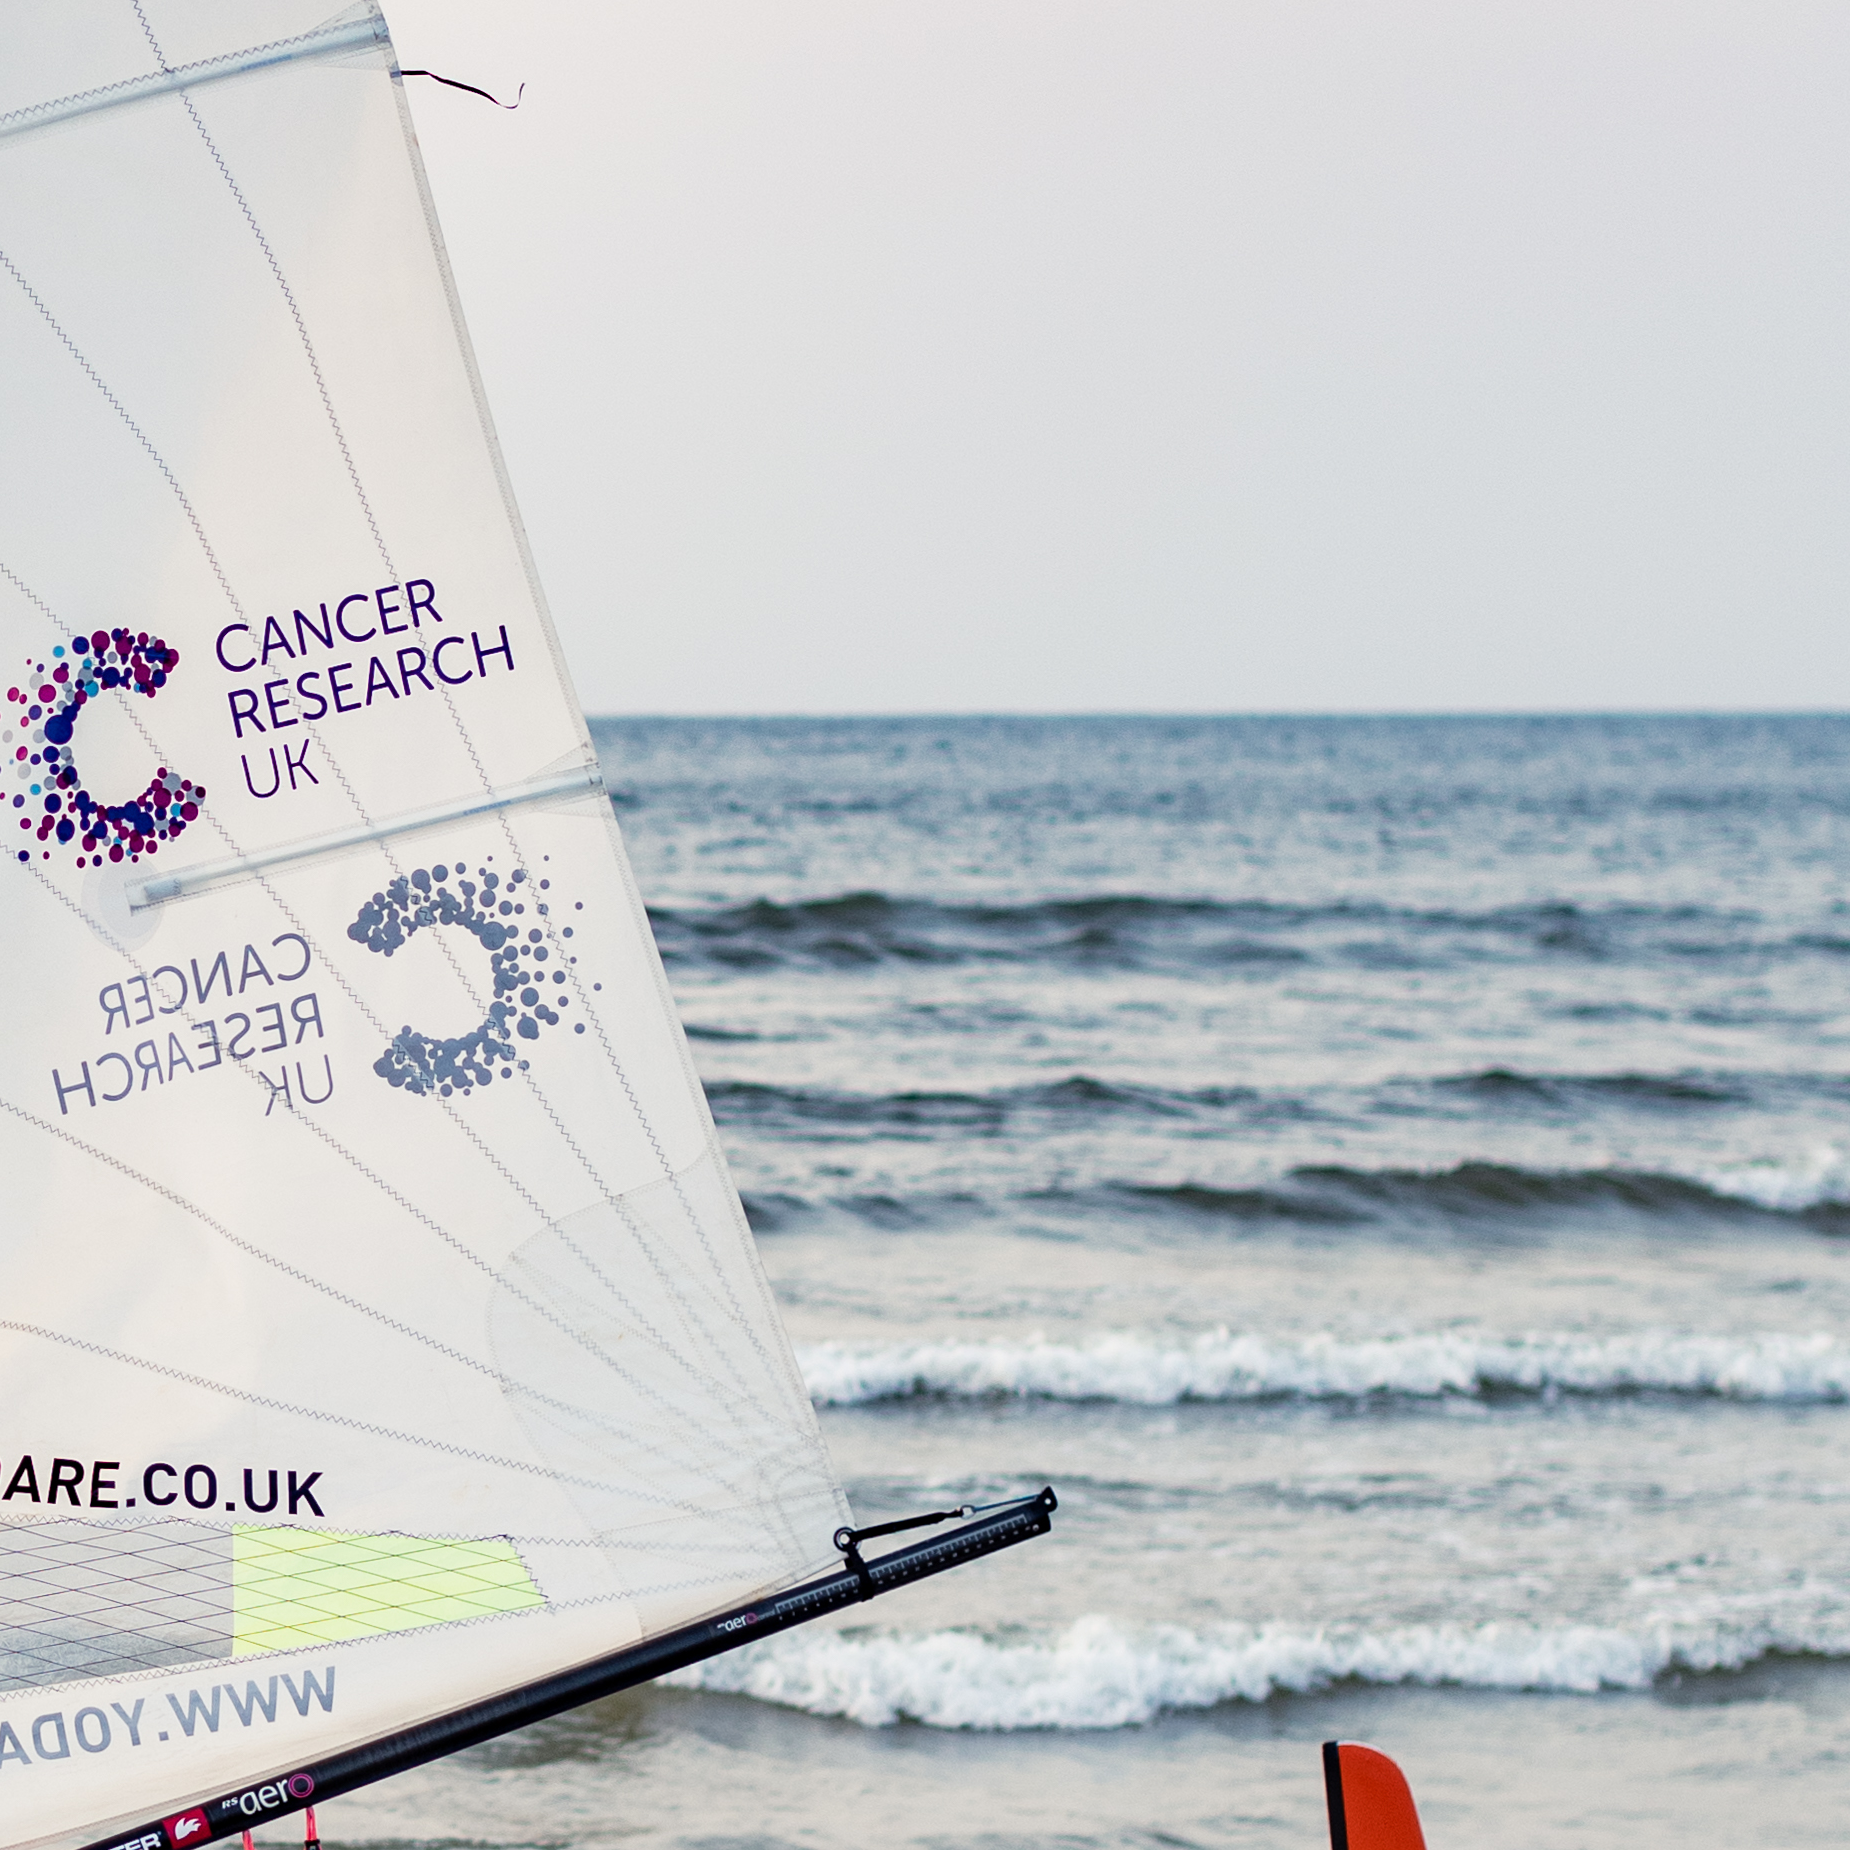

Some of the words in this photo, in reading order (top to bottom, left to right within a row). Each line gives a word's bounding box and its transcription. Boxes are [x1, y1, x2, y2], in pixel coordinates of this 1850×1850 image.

[214, 578, 443, 672] CANCER
[227, 625, 516, 739] RESEARCH
[241, 738, 320, 799] UK
[239, 1773, 314, 1815] aero
